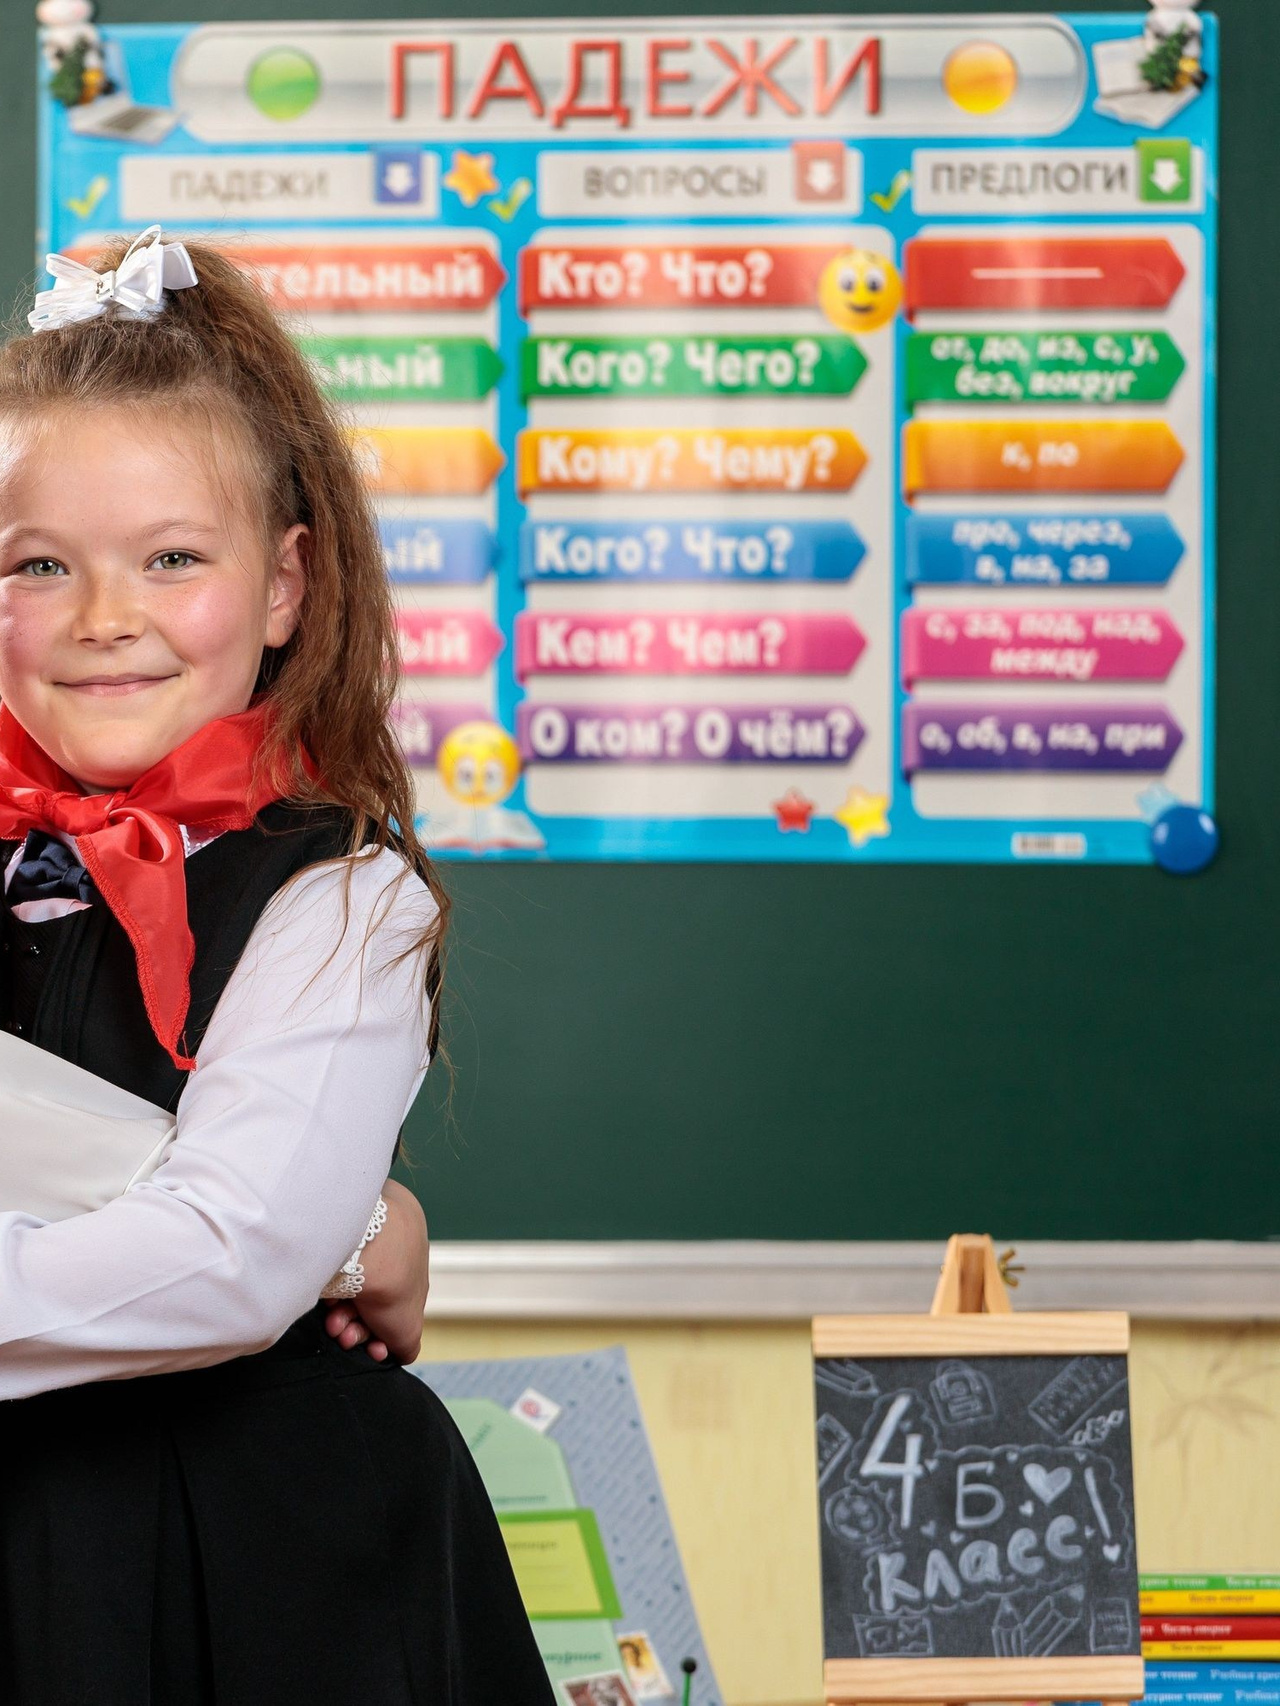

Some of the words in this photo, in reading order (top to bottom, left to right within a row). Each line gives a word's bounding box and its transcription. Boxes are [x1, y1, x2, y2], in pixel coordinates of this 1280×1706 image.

[391, 36, 881, 128] ПАДЕЖИ
[170, 169, 329, 201] ПАДЕЖИ
[584, 164, 767, 199] ВОПРОСЫ
[930, 161, 1129, 197] ПРЕДЛОГИ
[538, 250, 649, 298] Кто?
[660, 249, 773, 297] Что?
[537, 340, 672, 387] Кого?
[684, 339, 821, 386] Чего?
[930, 336, 975, 362] от,
[979, 336, 1030, 366] до,
[1037, 336, 1087, 365] из,
[954, 362, 1023, 400] без,
[1028, 369, 1137, 400] вокруг
[536, 438, 681, 490] Кому?
[695, 435, 838, 489] Чему?
[534, 526, 670, 572] Кого?
[681, 526, 795, 571] Что?
[952, 519, 1021, 552] про,
[1027, 519, 1132, 552] через,
[536, 621, 656, 667] Кем?
[667, 620, 787, 666] Чем?
[1018, 612, 1086, 645] под,
[1092, 612, 1162, 646] над,
[990, 647, 1100, 681] между
[530, 708, 569, 753] О
[575, 709, 685, 754] ком?
[694, 708, 731, 753] О
[740, 706, 855, 753] чём?
[1104, 722, 1167, 757] при
[860, 1394, 924, 1529] 4
[956, 1461, 1006, 1528] Б
